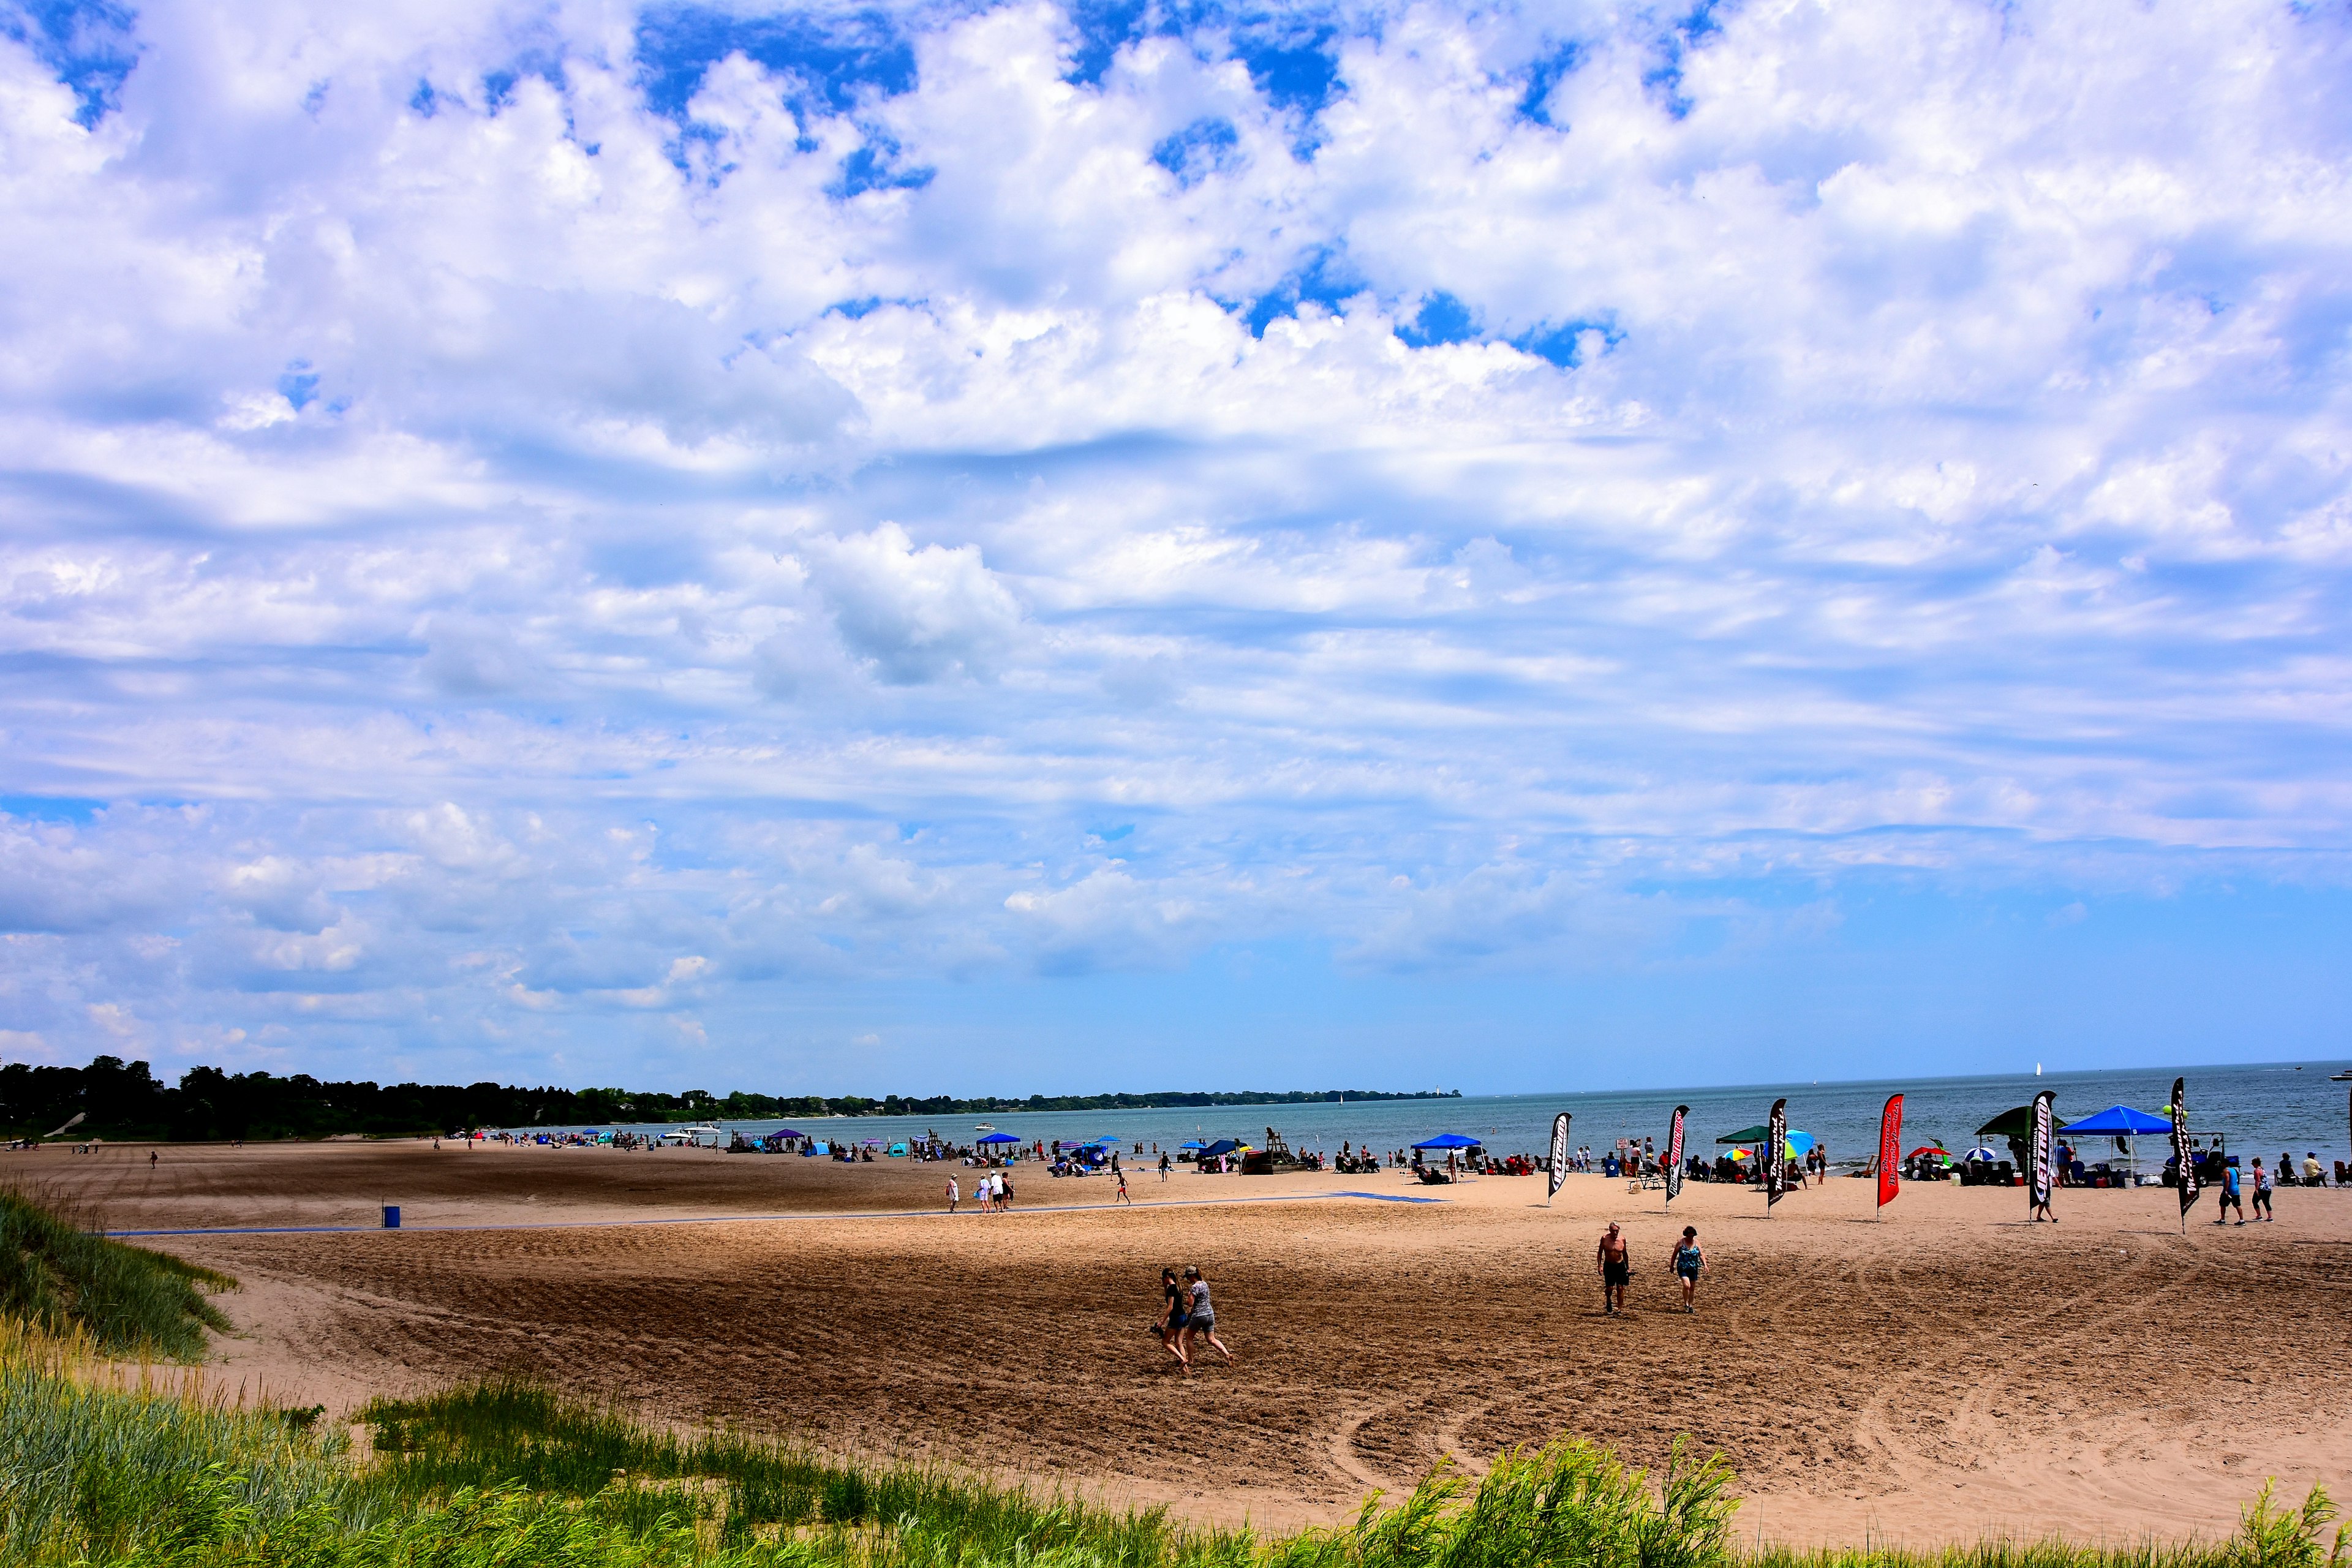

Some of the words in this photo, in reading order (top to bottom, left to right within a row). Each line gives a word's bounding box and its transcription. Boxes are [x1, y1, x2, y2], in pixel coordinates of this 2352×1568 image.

[1554, 1120, 1565, 1185] JETTRIM
[1671, 1110, 1683, 1166] WATERCROSS
[1776, 1108, 1785, 1191] Motorsports
[1881, 1112, 1891, 1174] Broward
[1888, 1102, 1900, 1187] Motorsports
[2037, 1102, 2048, 1190] JETTRIM
[2173, 1104, 2188, 1178] Broward
